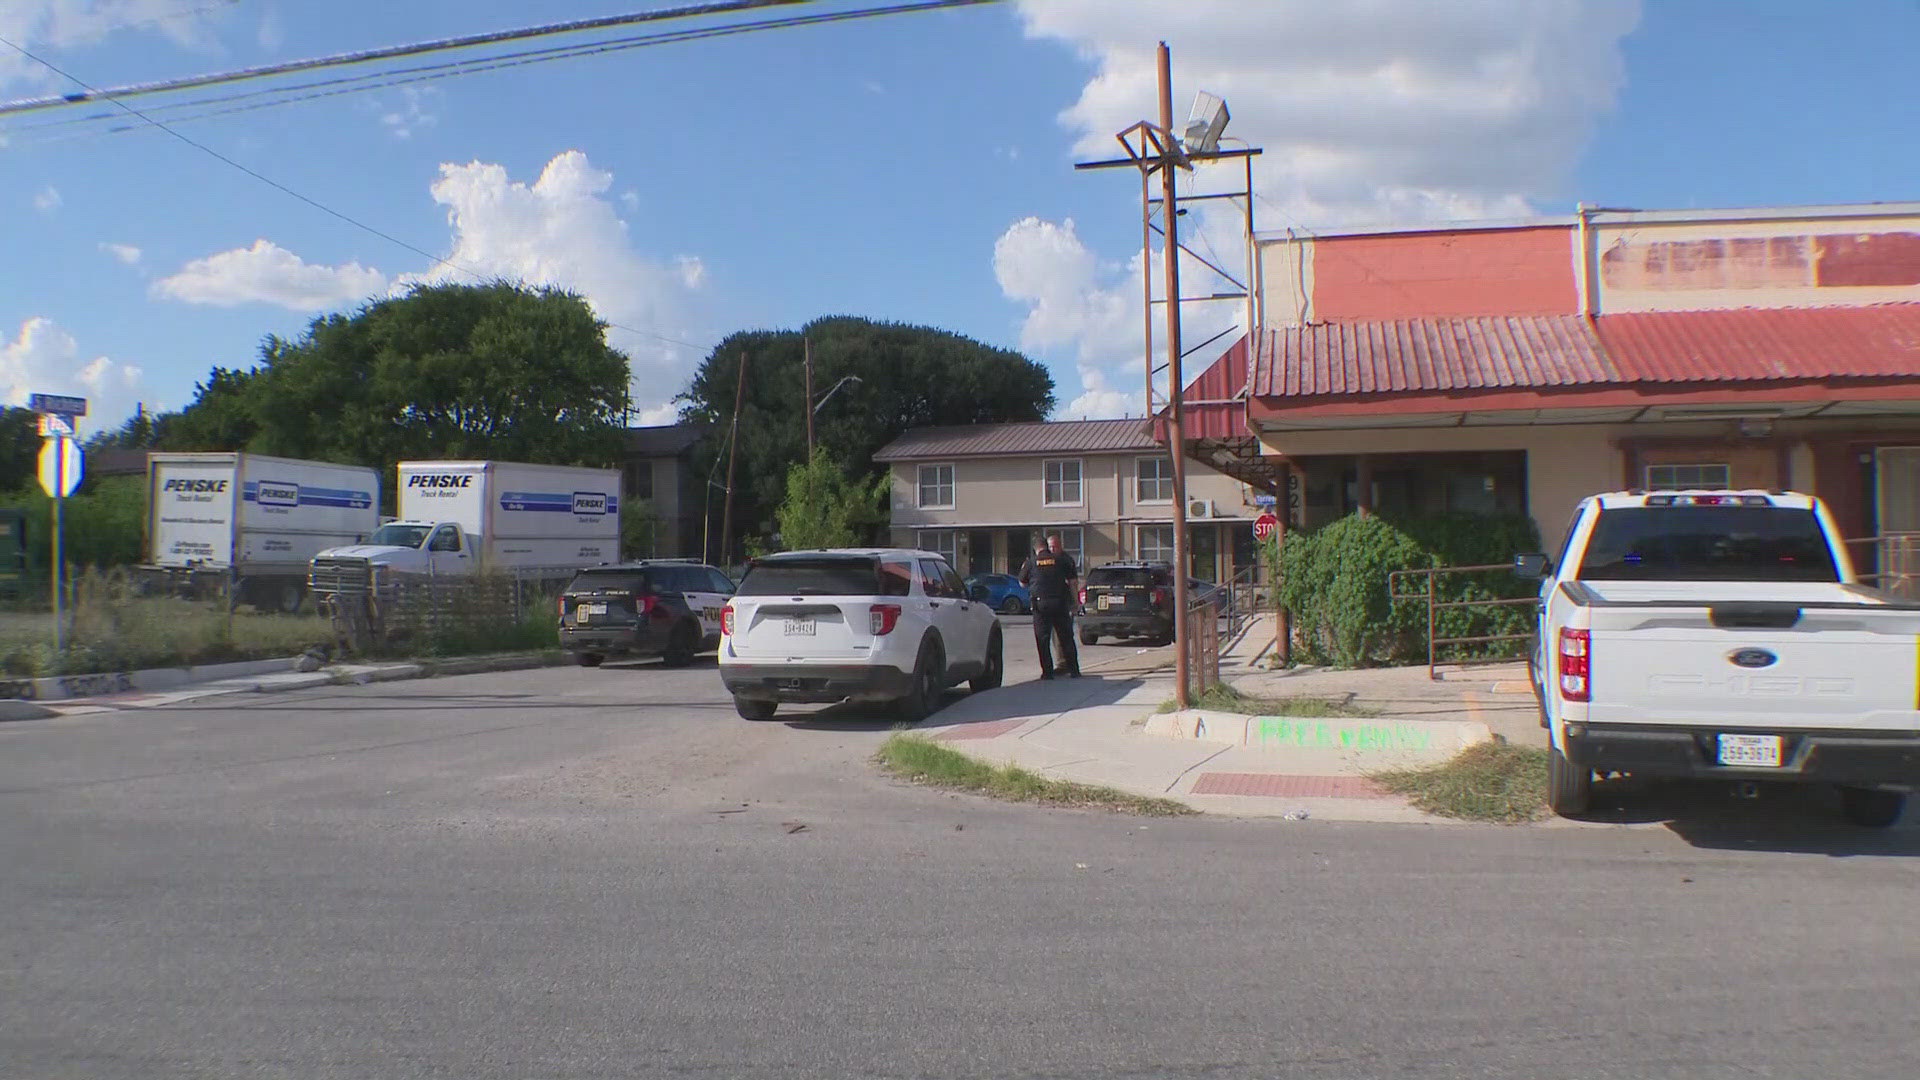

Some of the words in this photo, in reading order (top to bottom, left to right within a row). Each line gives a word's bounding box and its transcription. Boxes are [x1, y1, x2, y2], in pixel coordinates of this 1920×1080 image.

[163, 479, 228, 493] PENSKE
[408, 475, 473, 488] PENSKE
[261, 488, 297, 499] PENSKE
[575, 499, 604, 509] PENSKE
[1255, 523, 1275, 535] STO
